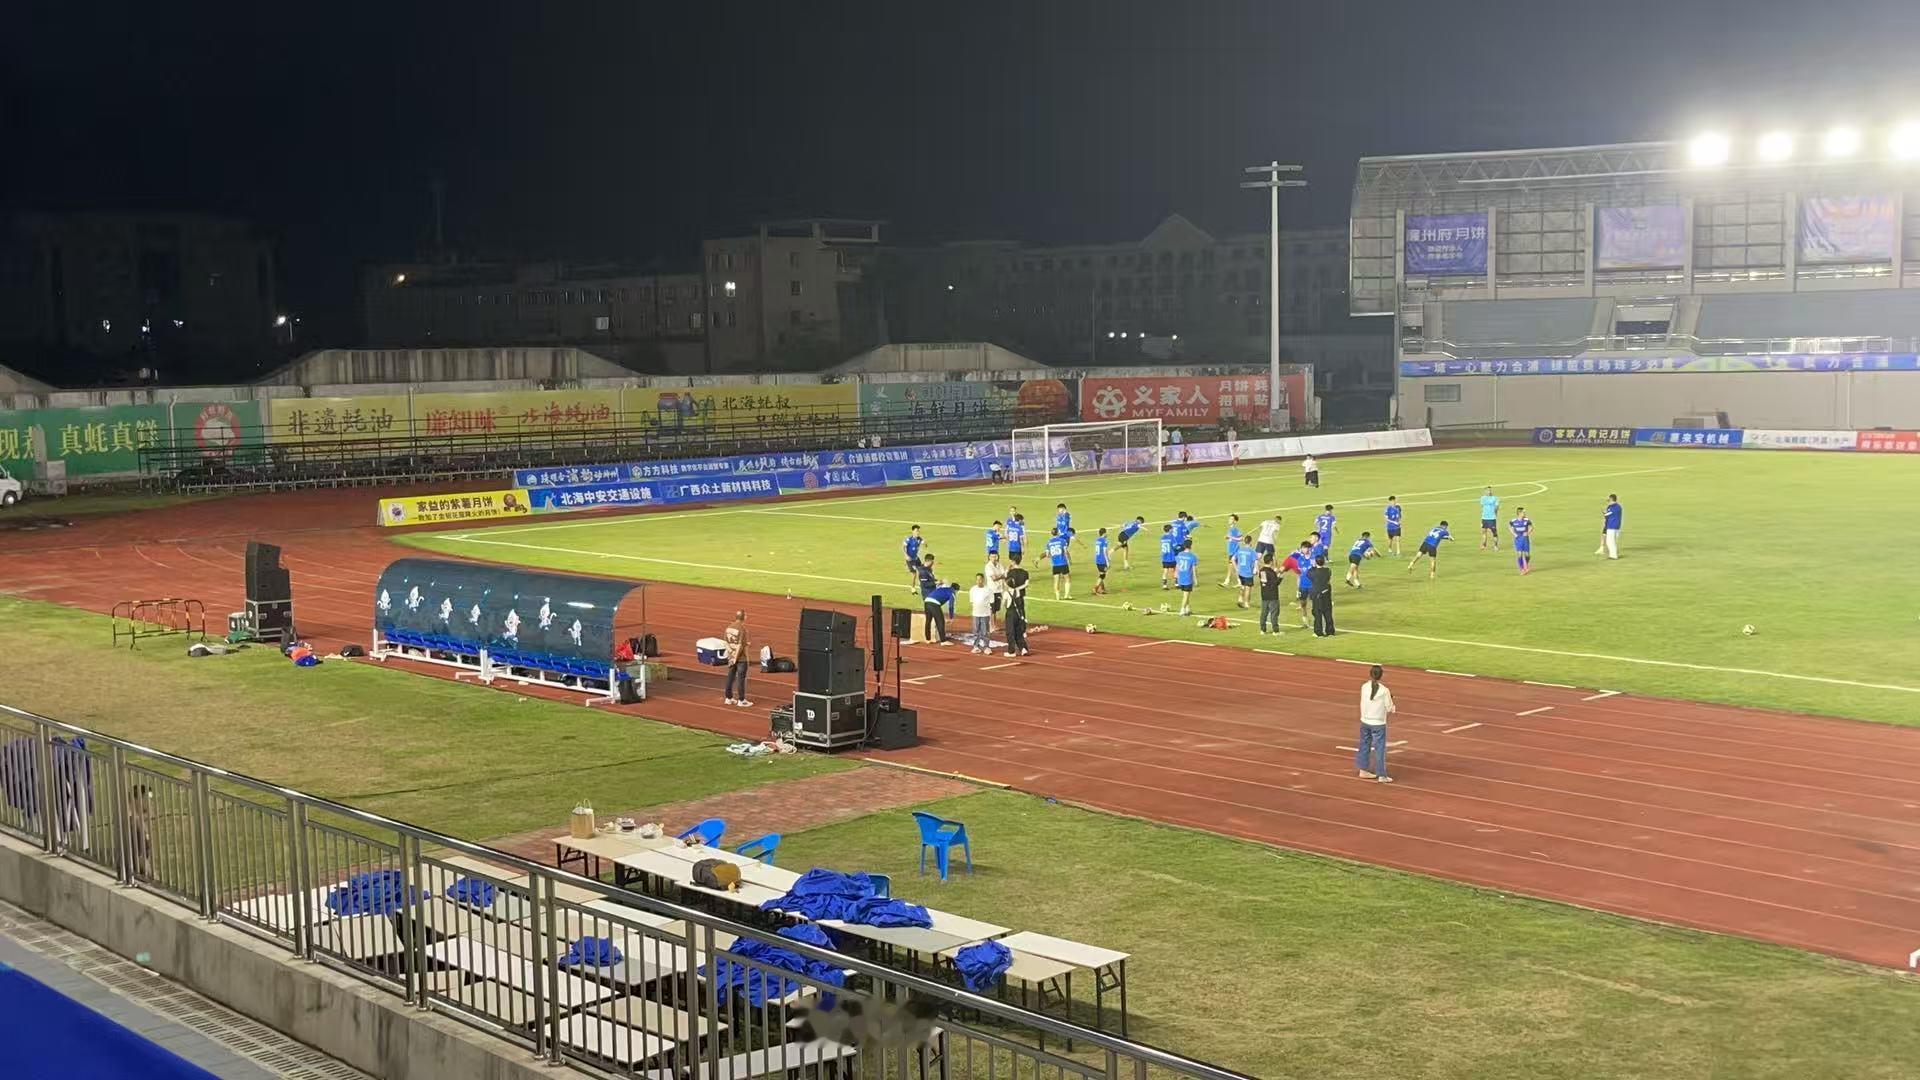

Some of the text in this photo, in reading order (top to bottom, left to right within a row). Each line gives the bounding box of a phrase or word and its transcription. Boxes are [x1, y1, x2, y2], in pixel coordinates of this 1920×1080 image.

[1132, 385, 1210, 406] 义家人
[910, 400, 990, 420] 海鲜月饼
[1132, 407, 1209, 418] MYFAMILY
[288, 407, 393, 435] 非遗蚝油
[59, 419, 159, 457] 真蚝真鲜
[642, 464, 679, 477] 方方科技
[824, 470, 860, 483] 中国银行
[561, 486, 652, 506] 北海中安交通设施
[680, 479, 771, 497] 广西众土新材料科技
[1321, 519, 1328, 530] 2
